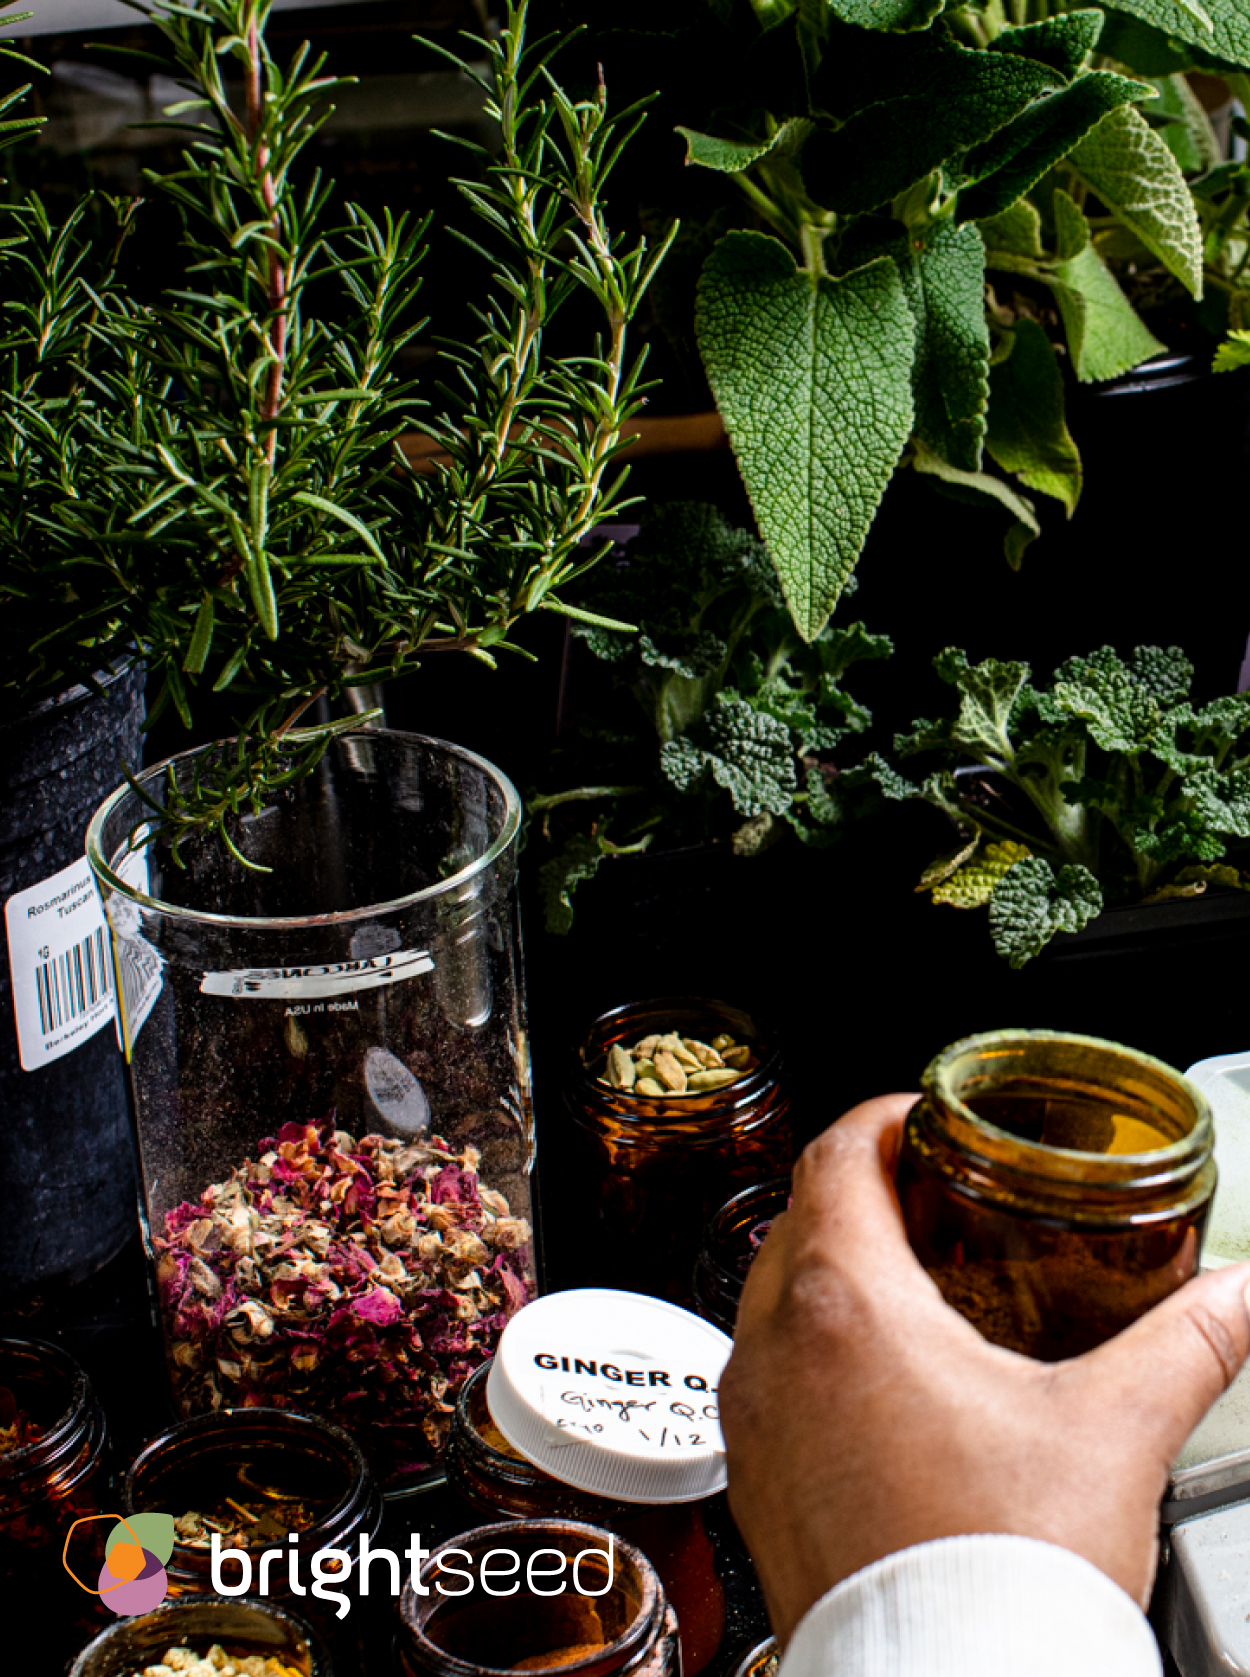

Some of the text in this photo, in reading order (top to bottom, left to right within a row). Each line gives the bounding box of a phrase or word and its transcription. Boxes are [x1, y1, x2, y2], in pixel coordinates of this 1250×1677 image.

[28, 875, 92, 919] Rosmarinus
[57, 889, 95, 918] Tuscan
[533, 1353, 672, 1387] GINGER
[560, 1391, 657, 1422] Ginger
